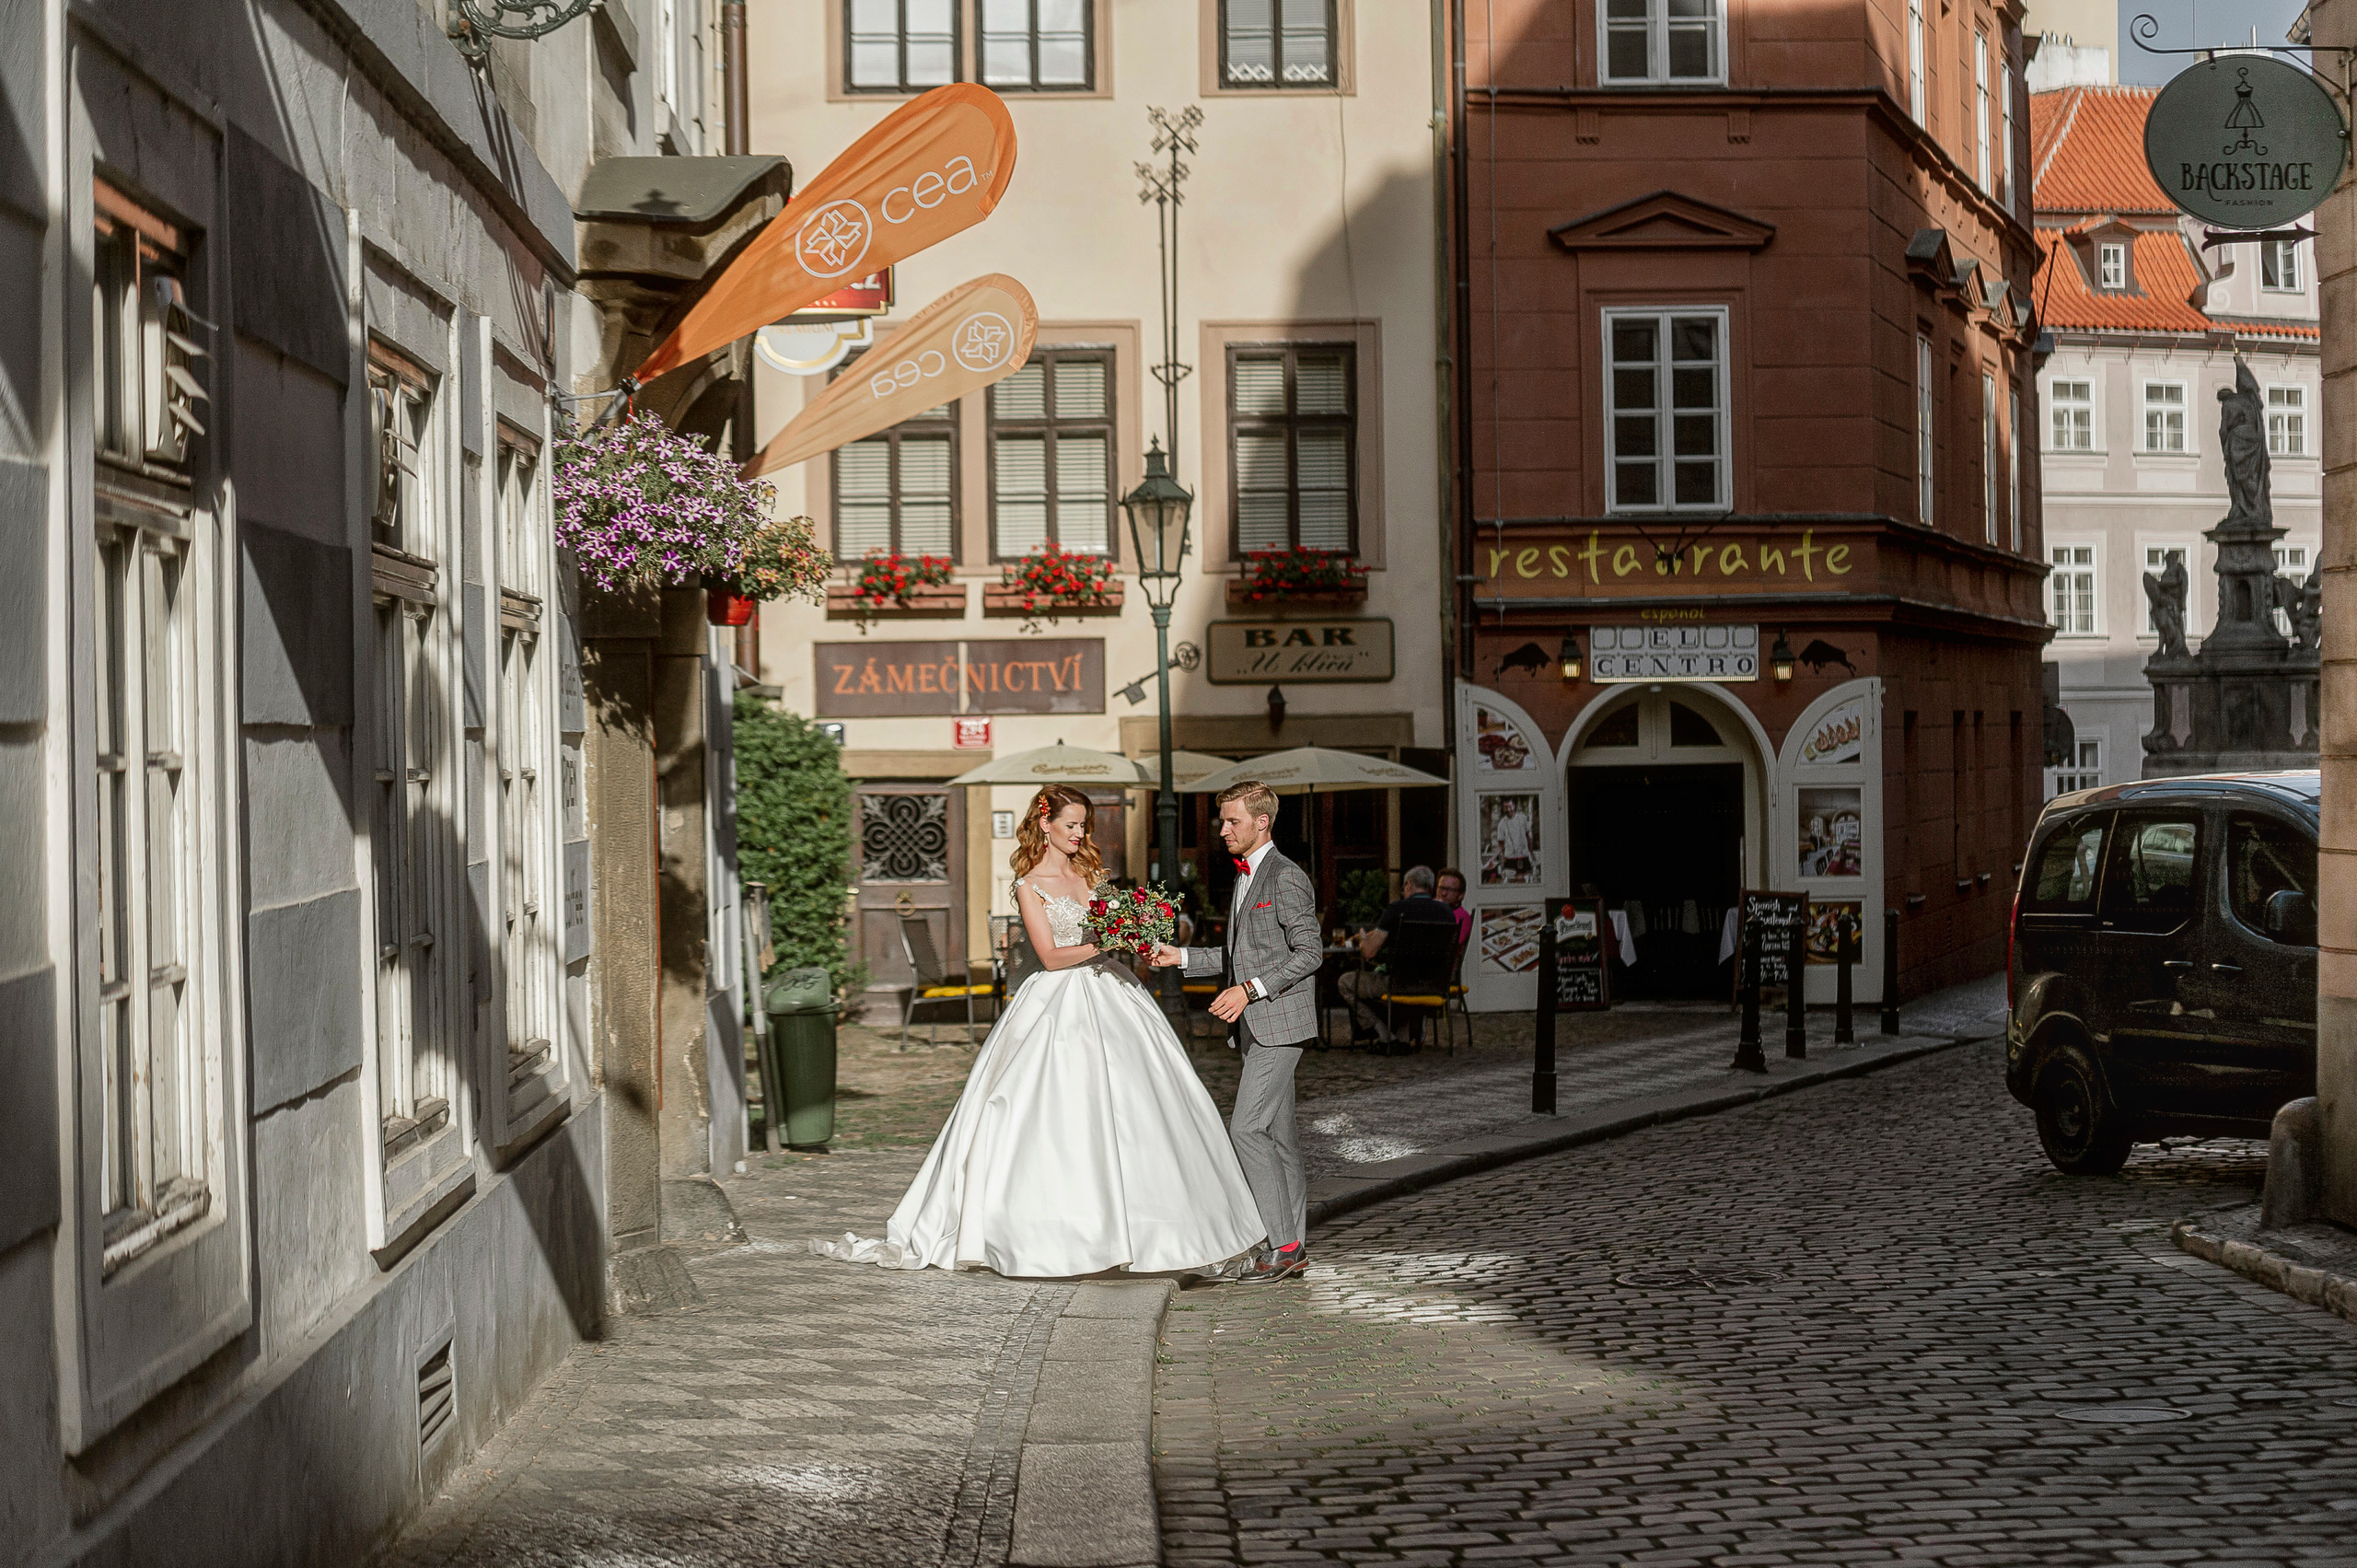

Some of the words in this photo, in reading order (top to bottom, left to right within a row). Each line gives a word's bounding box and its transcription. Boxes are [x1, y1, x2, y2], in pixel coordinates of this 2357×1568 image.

[881, 155, 979, 224] cea
[2179, 162, 2314, 201] BACKSTAGE
[1488, 528, 1852, 585] restaurante
[1245, 627, 1356, 648] BAR
[1653, 630, 1697, 645] EL
[832, 653, 1084, 695] ZÁMEČNICTVÍ
[1597, 657, 1753, 674] CENTRO
